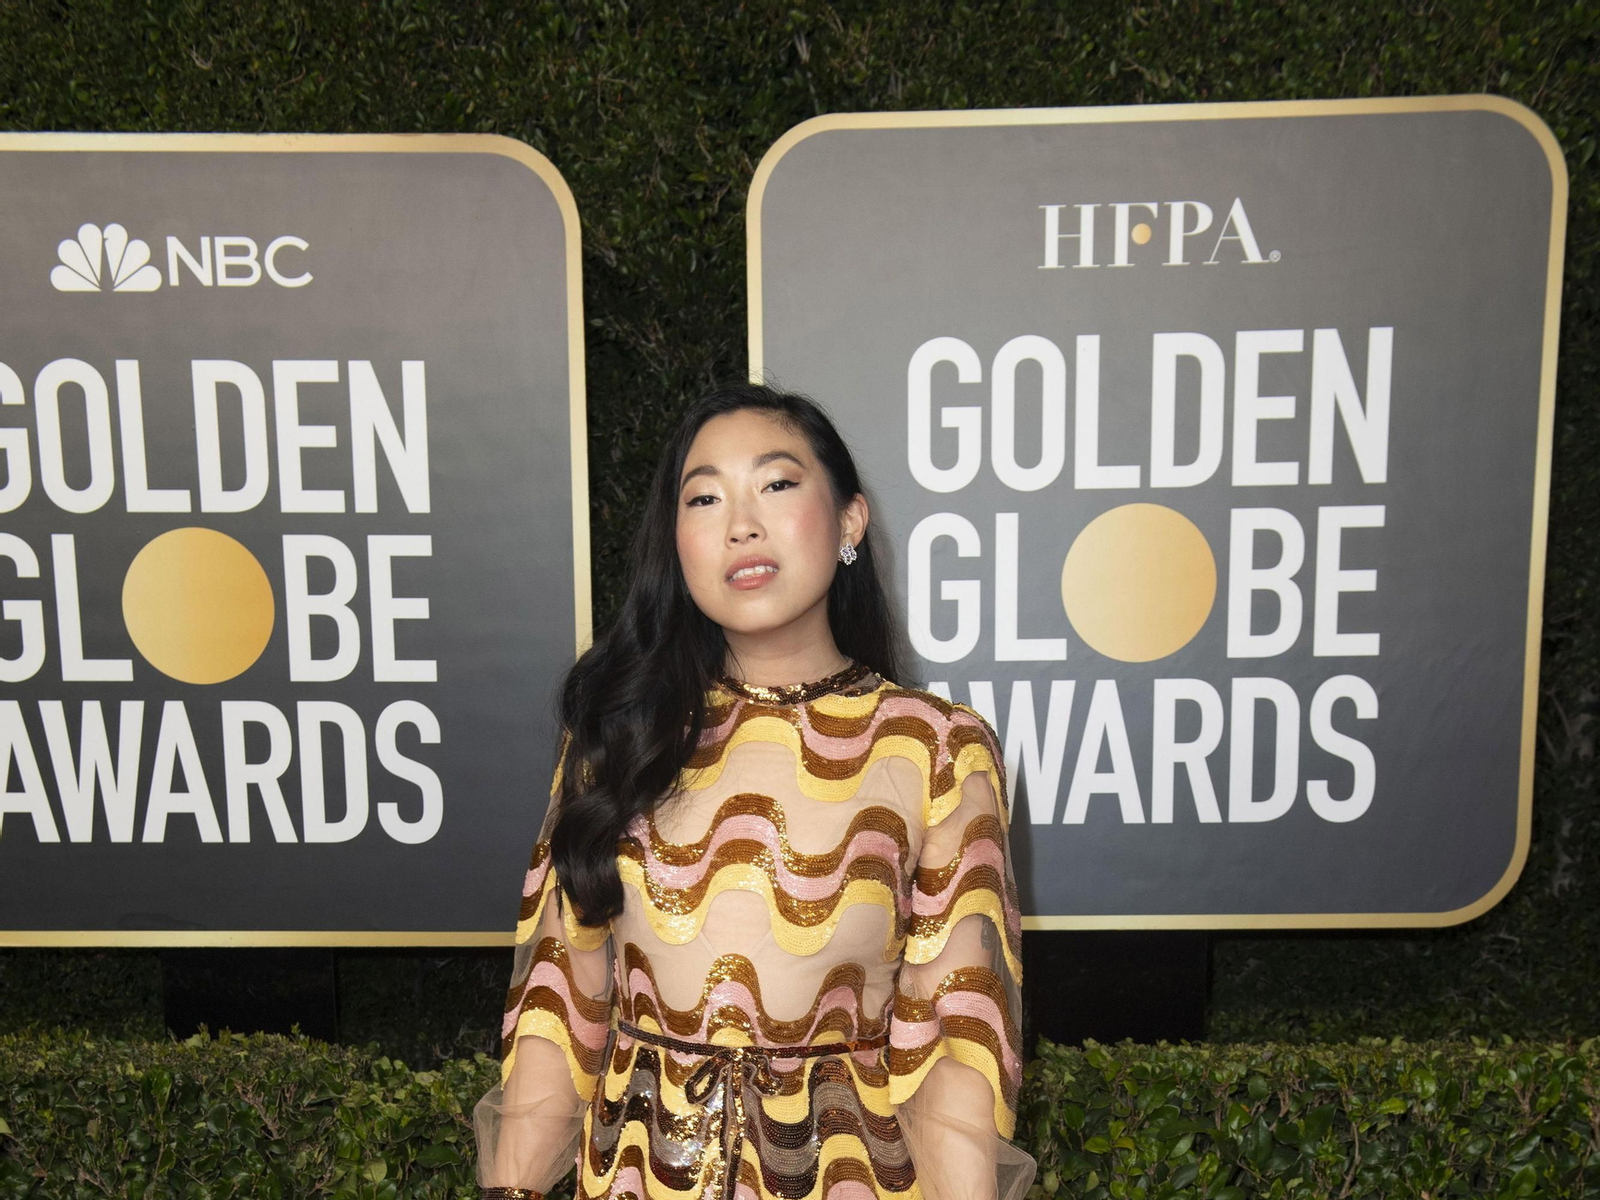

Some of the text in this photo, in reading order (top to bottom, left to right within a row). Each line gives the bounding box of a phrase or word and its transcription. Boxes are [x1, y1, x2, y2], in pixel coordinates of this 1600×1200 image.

[166, 236, 314, 286] NBC
[907, 327, 1394, 493] GOLDEN
[907, 503, 1387, 663] GLOBE
[0, 700, 444, 845] AWARDS
[927, 674, 1380, 825] WARDS
